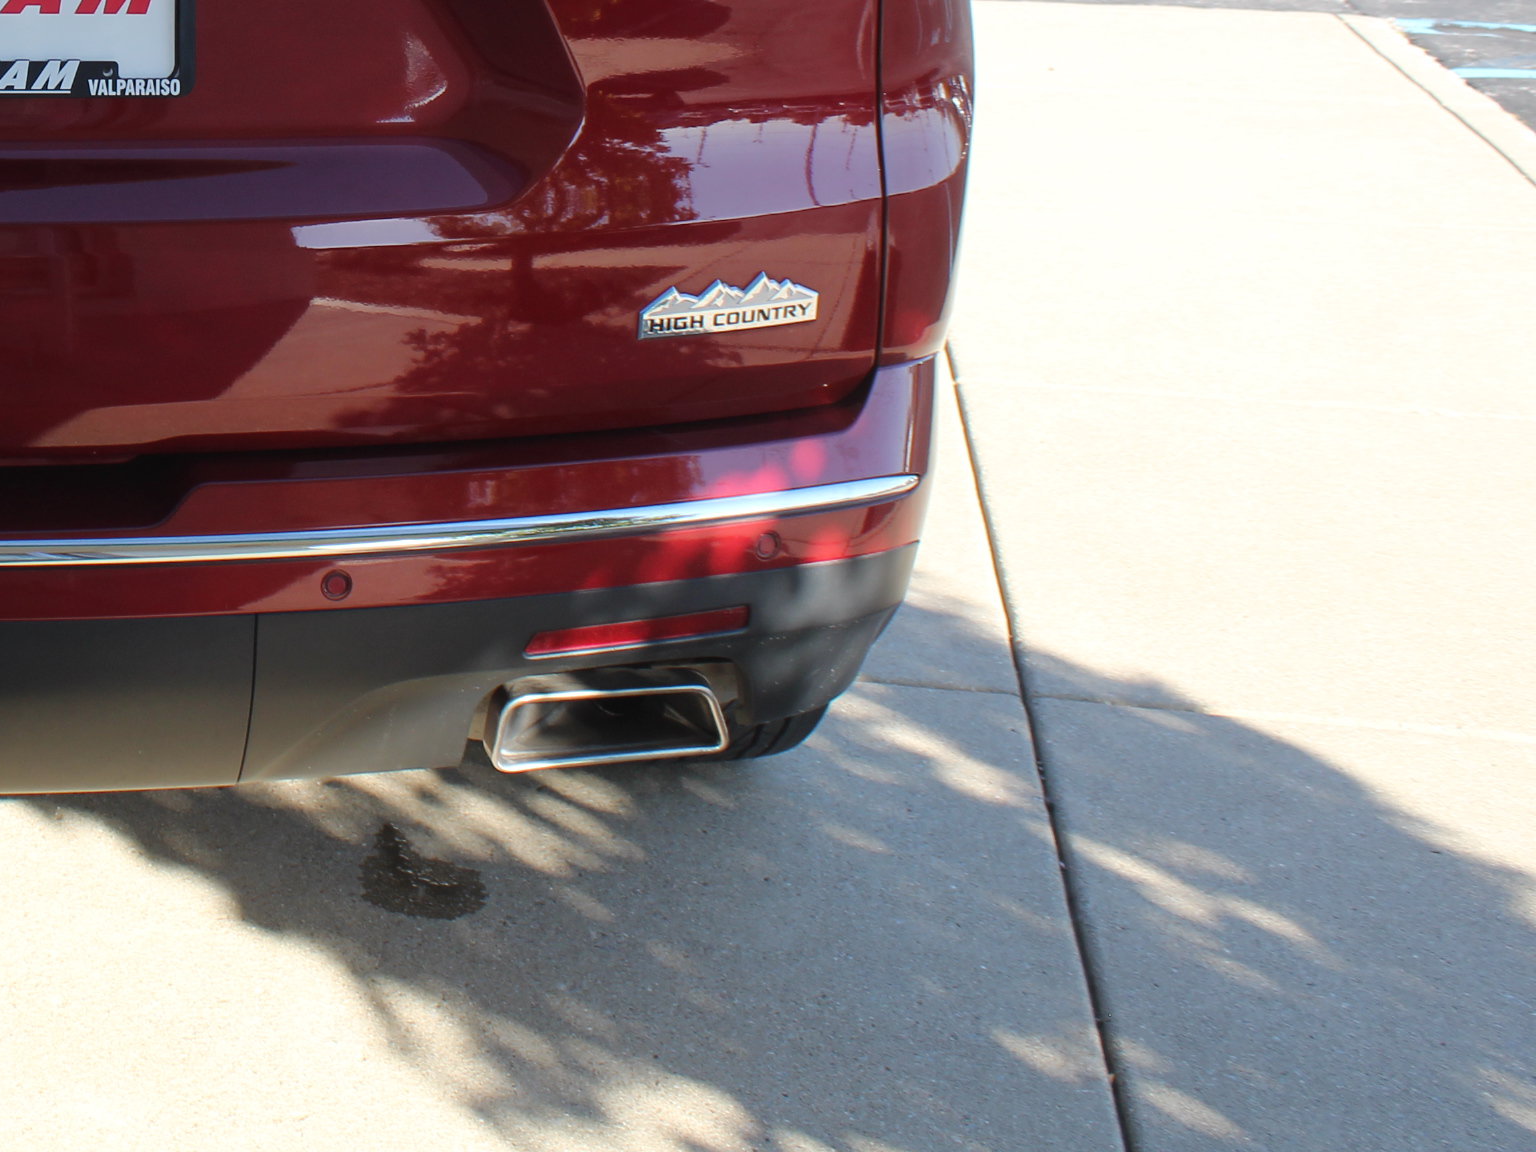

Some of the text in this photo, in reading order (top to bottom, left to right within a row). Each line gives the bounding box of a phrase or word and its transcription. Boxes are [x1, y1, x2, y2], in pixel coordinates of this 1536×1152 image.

[88, 78, 181, 97] VALPARAISO
[648, 303, 812, 333] HIGH COUNTRY
